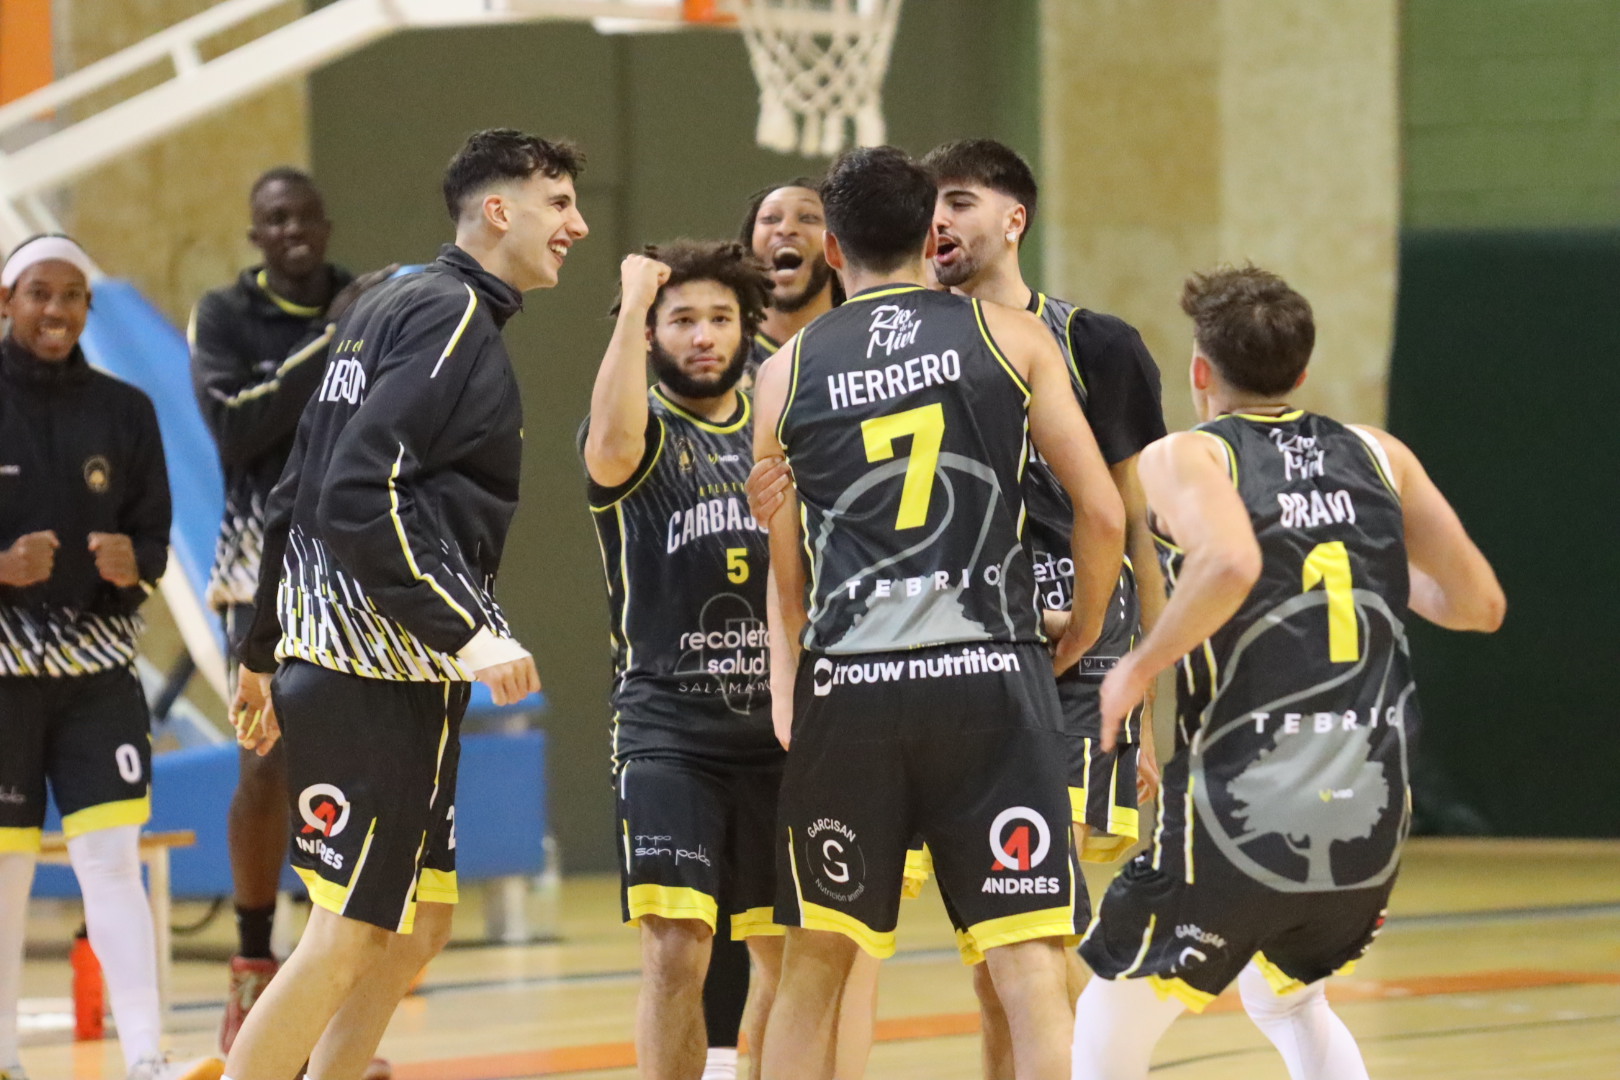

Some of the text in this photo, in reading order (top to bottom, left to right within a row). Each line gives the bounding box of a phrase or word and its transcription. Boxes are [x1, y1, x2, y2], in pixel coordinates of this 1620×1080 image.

[827, 349, 961, 410] HERRERO
[861, 402, 945, 530] 7
[726, 547, 750, 585] 5
[845, 562, 1002, 600] TEBRIO
[1302, 540, 1359, 663] 1
[707, 649, 766, 675] salud
[832, 646, 1020, 687] trouw nutrition
[115, 742, 143, 785] 0
[807, 817, 857, 843] GARCISAN
[635, 846, 672, 857] san
[981, 875, 1061, 895] ANDRÉS
